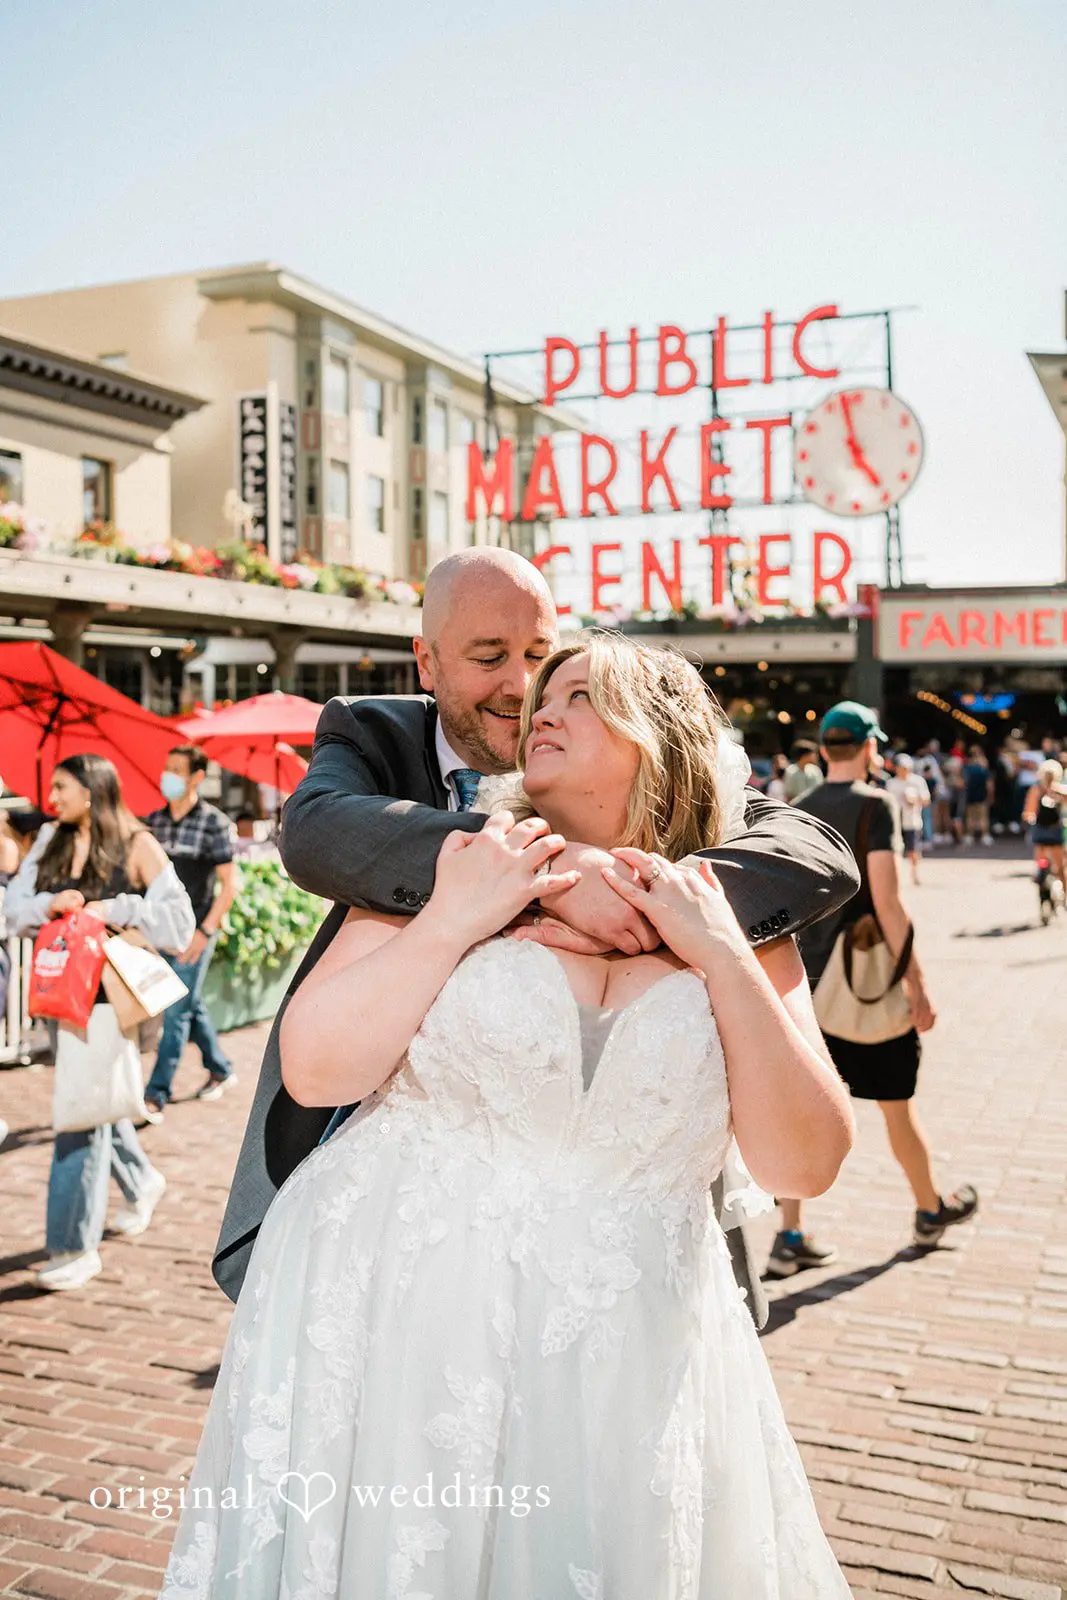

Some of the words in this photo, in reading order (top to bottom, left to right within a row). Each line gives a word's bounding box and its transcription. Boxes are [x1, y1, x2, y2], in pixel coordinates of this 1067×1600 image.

[541, 304, 839, 408] PUBLIC
[464, 415, 792, 524] MARKET
[897, 608, 1067, 651] FARME
